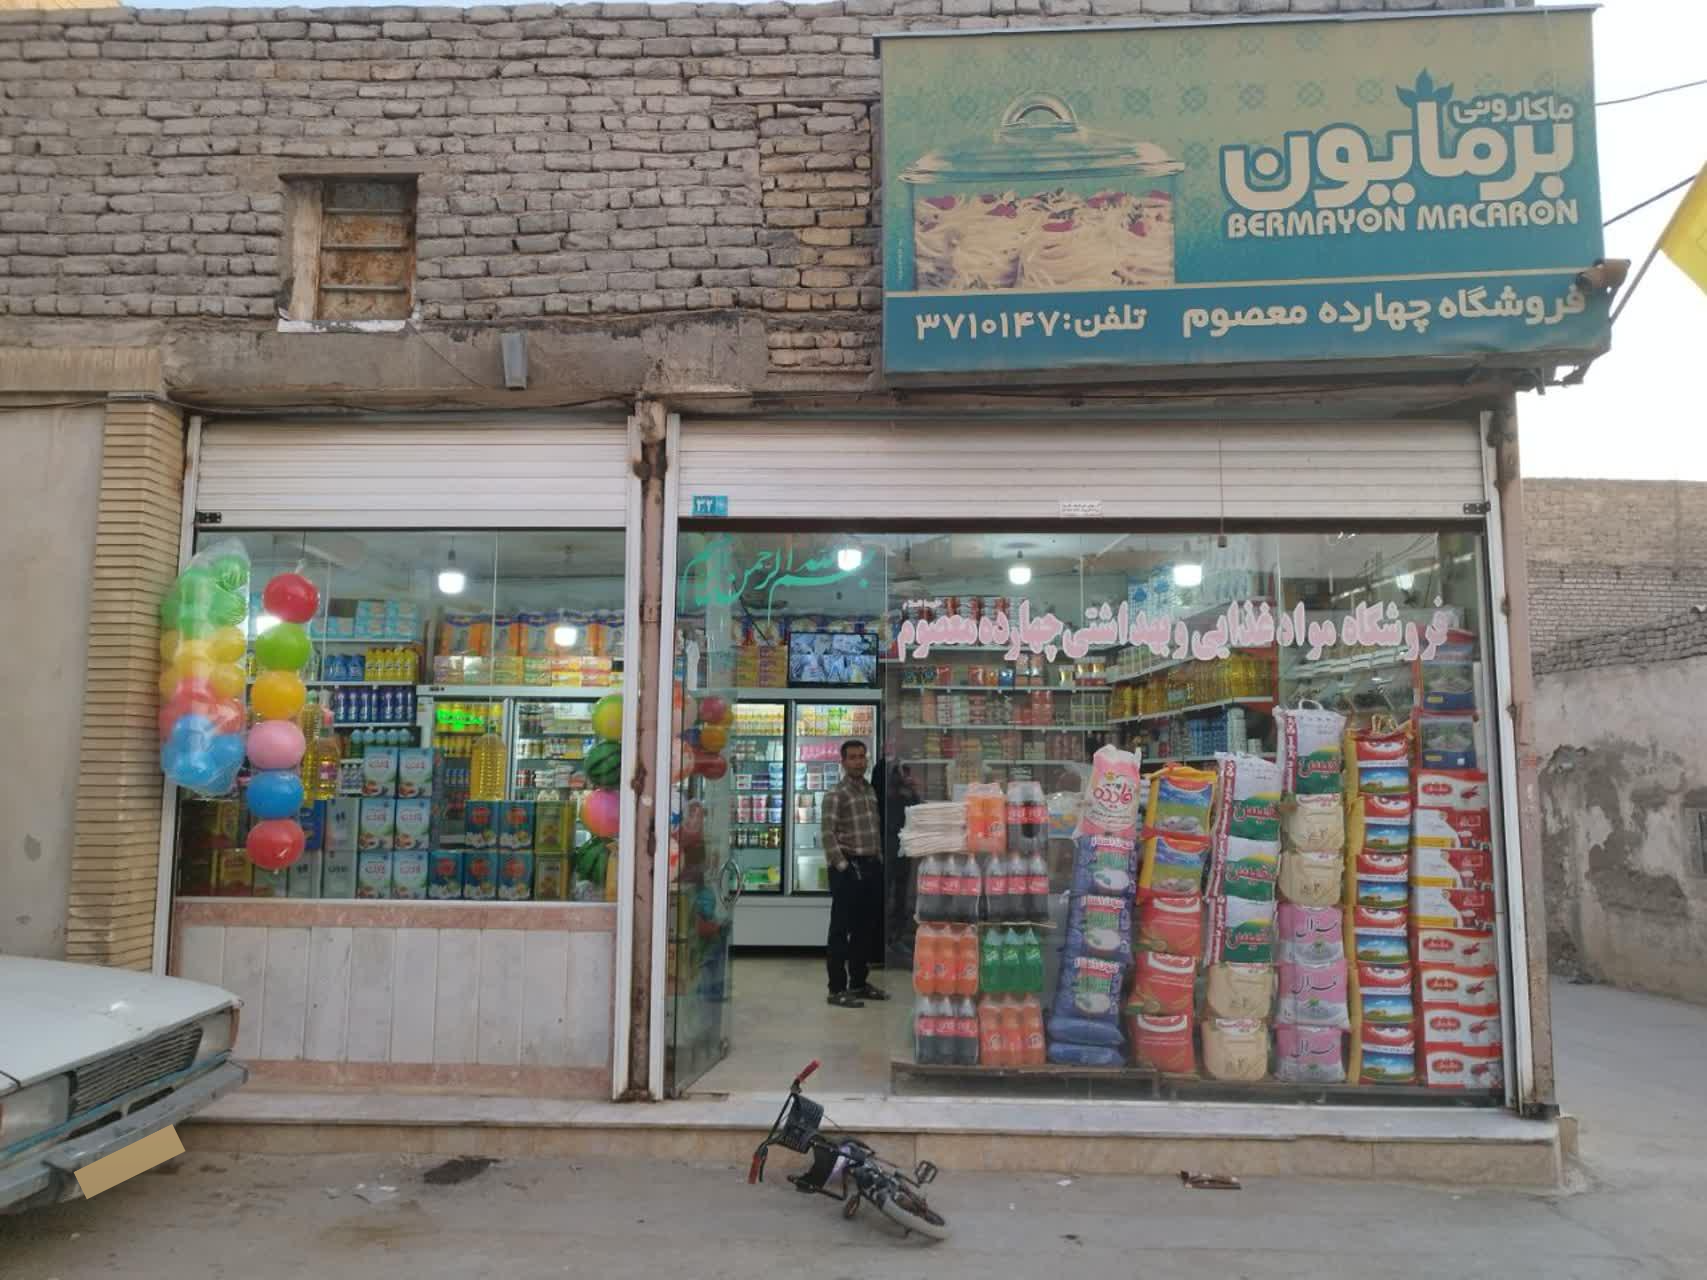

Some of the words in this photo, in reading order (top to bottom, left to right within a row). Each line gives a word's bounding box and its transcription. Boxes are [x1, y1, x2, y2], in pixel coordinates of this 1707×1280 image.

[1452, 96, 1574, 126] ماکارونی
[1224, 100, 1574, 210] برمایون
[1228, 206, 1406, 238] BERMAYON
[1417, 198, 1579, 230] MACARON
[1183, 304, 1307, 337] معصوم
[1318, 293, 1431, 332] چهارده
[1438, 285, 1585, 325] فروشگاه
[1277, 602, 1336, 660] مواد
[1341, 596, 1449, 660] فروشگاه
